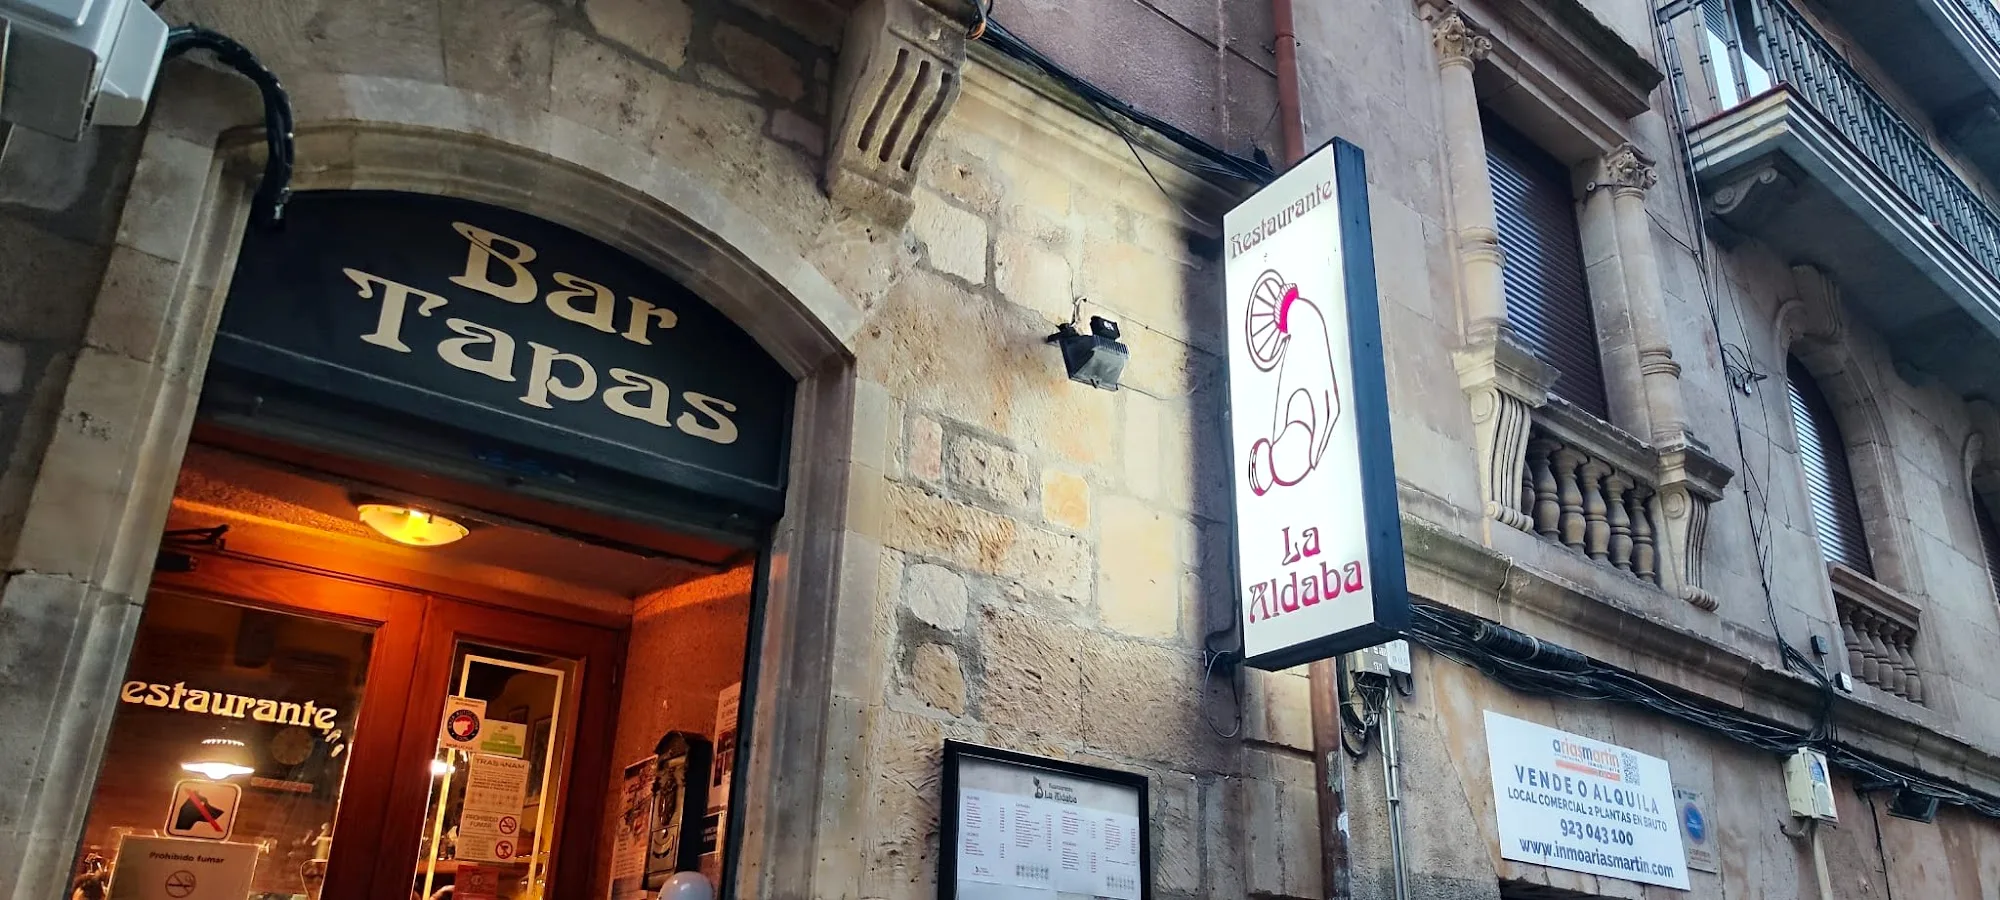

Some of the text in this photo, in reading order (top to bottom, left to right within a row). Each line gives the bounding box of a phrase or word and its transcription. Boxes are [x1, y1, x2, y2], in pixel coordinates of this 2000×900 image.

[1230, 180, 1333, 259] Restaurante
[448, 221, 678, 346] Bar
[342, 267, 739, 445] Tapas
[1281, 526, 1321, 566] La
[1249, 560, 1364, 624] Aldaba
[120, 680, 338, 729] estaurante
[1507, 786, 1668, 832] LOCAL COMERCIAL 2 PLANTAS EN BRUTO
[1514, 764, 1659, 815] VENDE O ALQUILA
[1560, 818, 1634, 846] 923 043 100
[149, 851, 225, 863] Prohibido fumar
[1519, 837, 1674, 879] www.inmoariasmartin.com
